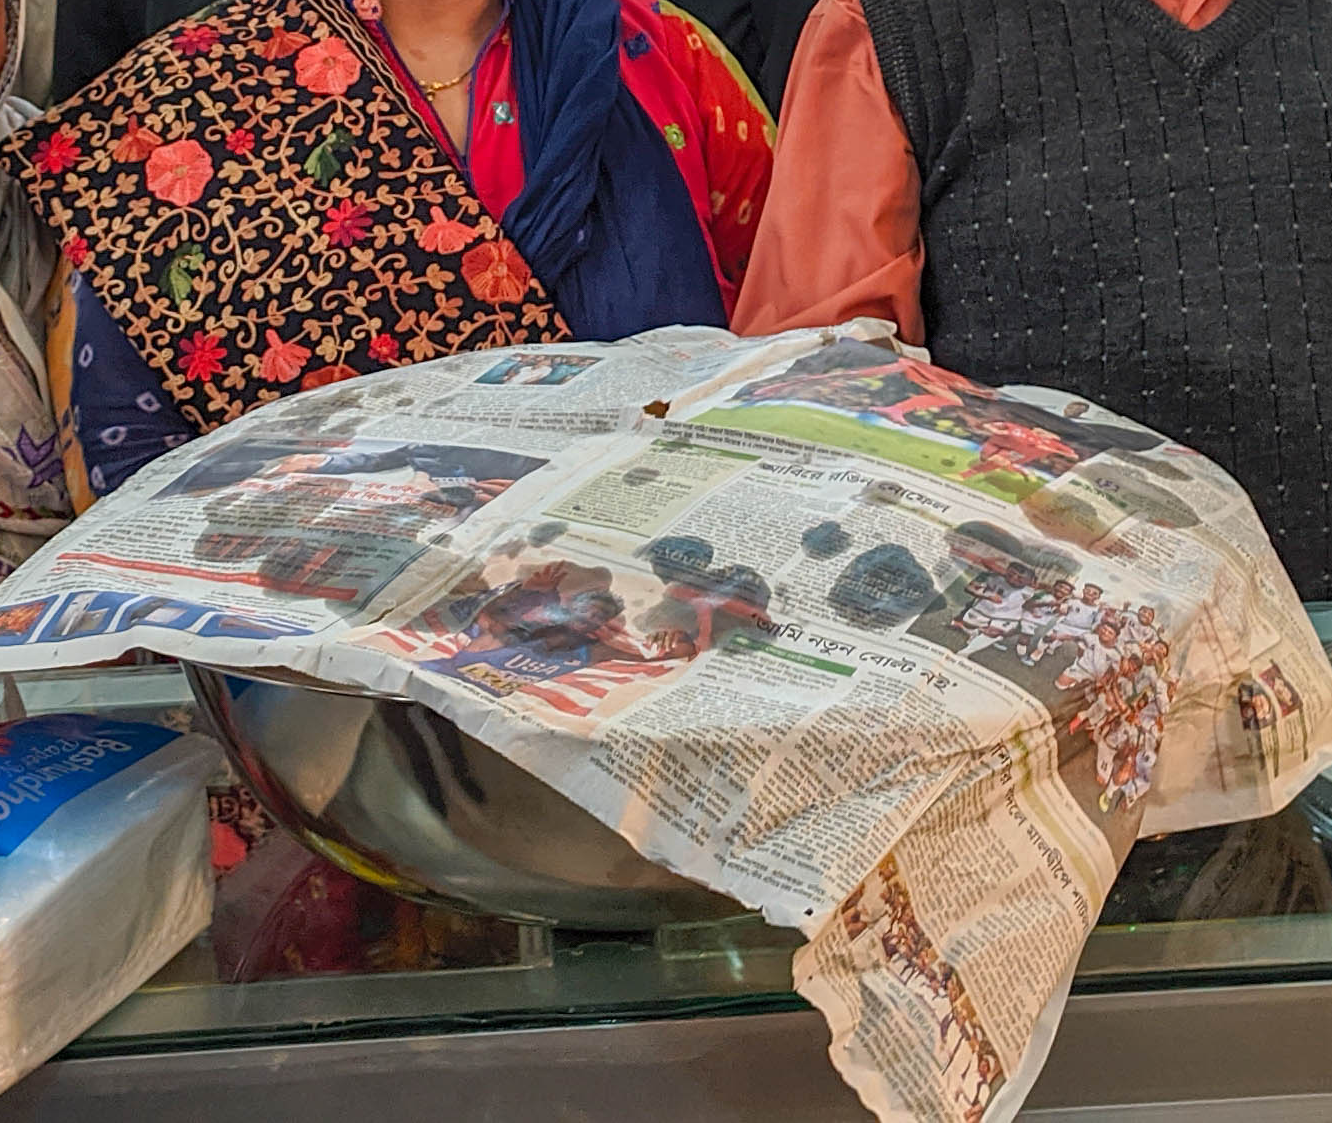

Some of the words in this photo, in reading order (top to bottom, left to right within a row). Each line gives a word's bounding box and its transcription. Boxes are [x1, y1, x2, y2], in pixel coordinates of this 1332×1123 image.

[759, 461, 825, 482] আবিরে
[503, 653, 561, 675] USA
[807, 634, 857, 658] নতুন
[858, 650, 918, 674] বোল্ট
